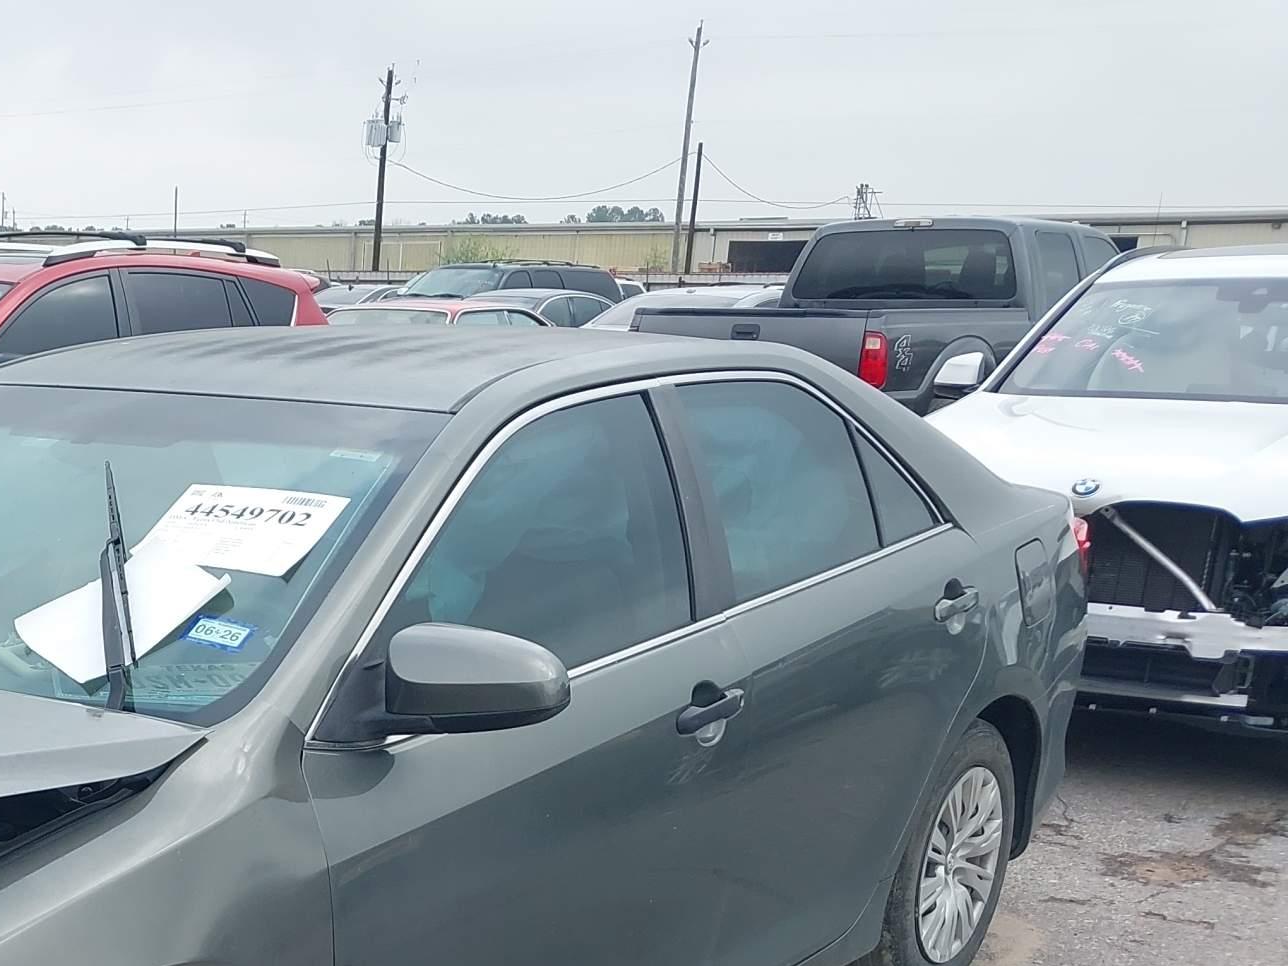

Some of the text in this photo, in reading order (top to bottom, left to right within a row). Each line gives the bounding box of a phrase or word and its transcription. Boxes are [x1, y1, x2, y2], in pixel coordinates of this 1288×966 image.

[185, 502, 312, 527] 44549702
[194, 623, 242, 642] 06 26
